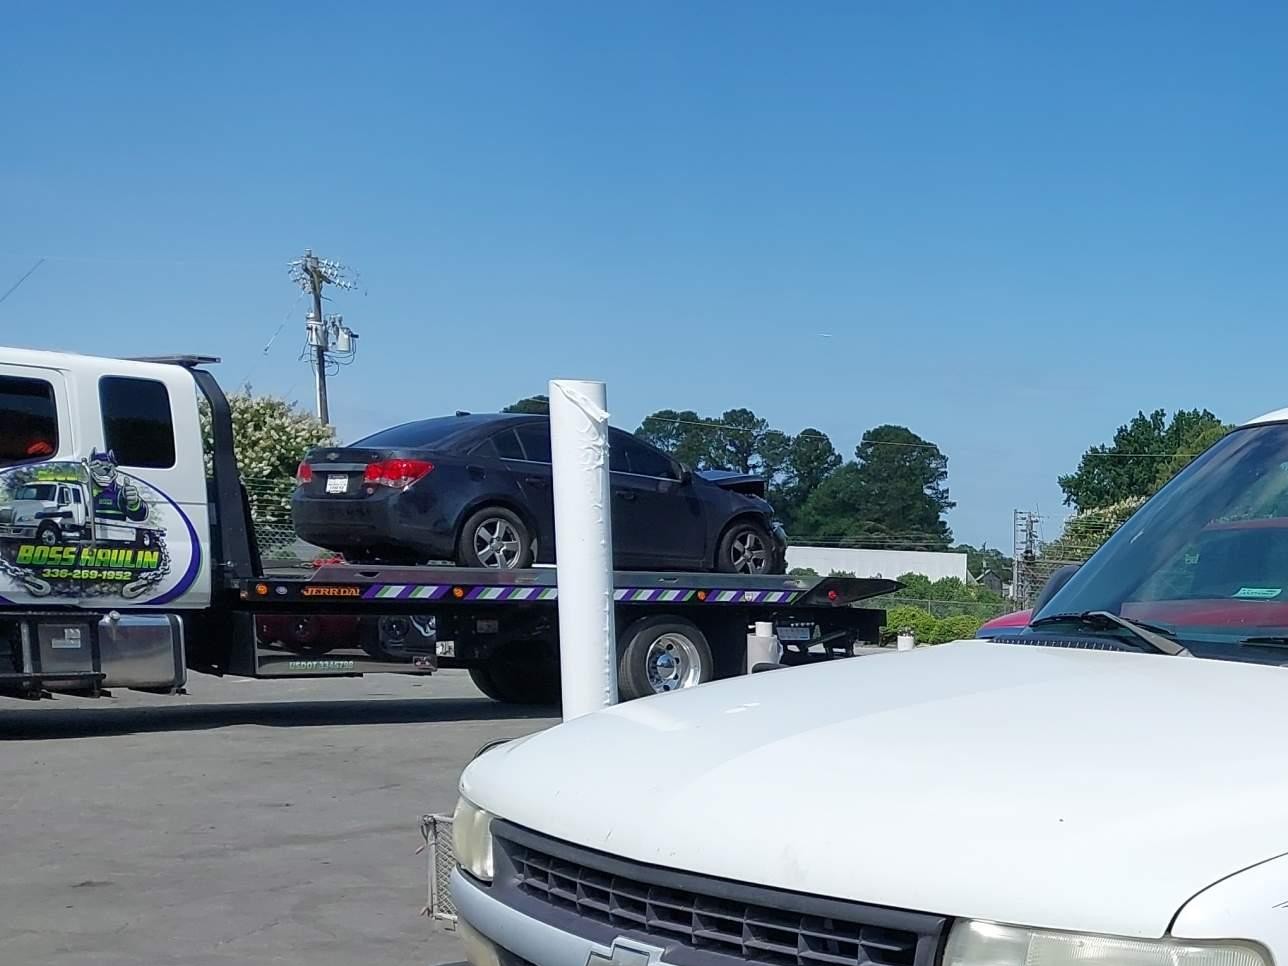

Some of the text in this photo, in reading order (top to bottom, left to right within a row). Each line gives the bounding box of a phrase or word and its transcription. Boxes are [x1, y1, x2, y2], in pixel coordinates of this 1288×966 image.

[15, 545, 159, 569] BOSS HAULIN
[41, 568, 132, 580] 336-269-1952
